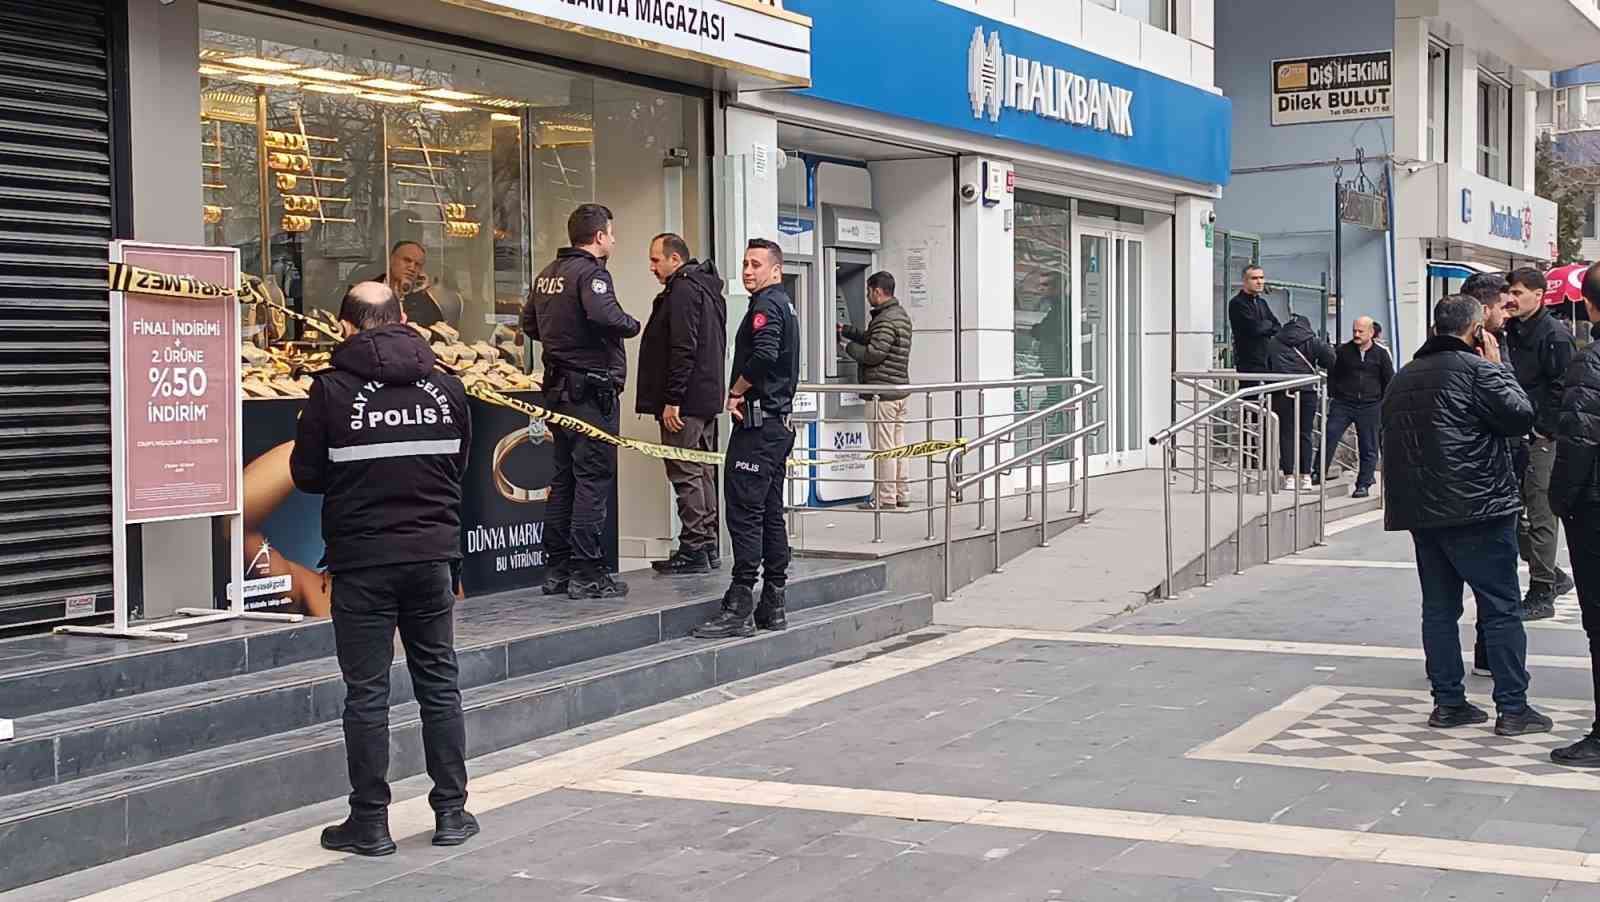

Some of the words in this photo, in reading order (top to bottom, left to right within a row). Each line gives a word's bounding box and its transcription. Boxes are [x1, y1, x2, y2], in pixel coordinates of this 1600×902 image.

[1004, 53, 1134, 137] HALKBANK
[1278, 94, 1322, 112] Dilek
[1328, 88, 1390, 108] BULUT
[133, 318, 170, 335] FİNAL
[172, 318, 220, 336] İNDİRİMİ
[164, 347, 204, 363] ÜRÜNE
[148, 367, 207, 397] %50
[350, 392, 368, 430] OLAY
[368, 404, 438, 428] POLİS
[467, 524, 506, 553] DÜNYA
[496, 555, 507, 571] BU
[510, 549, 544, 569] VİTRİNDE
